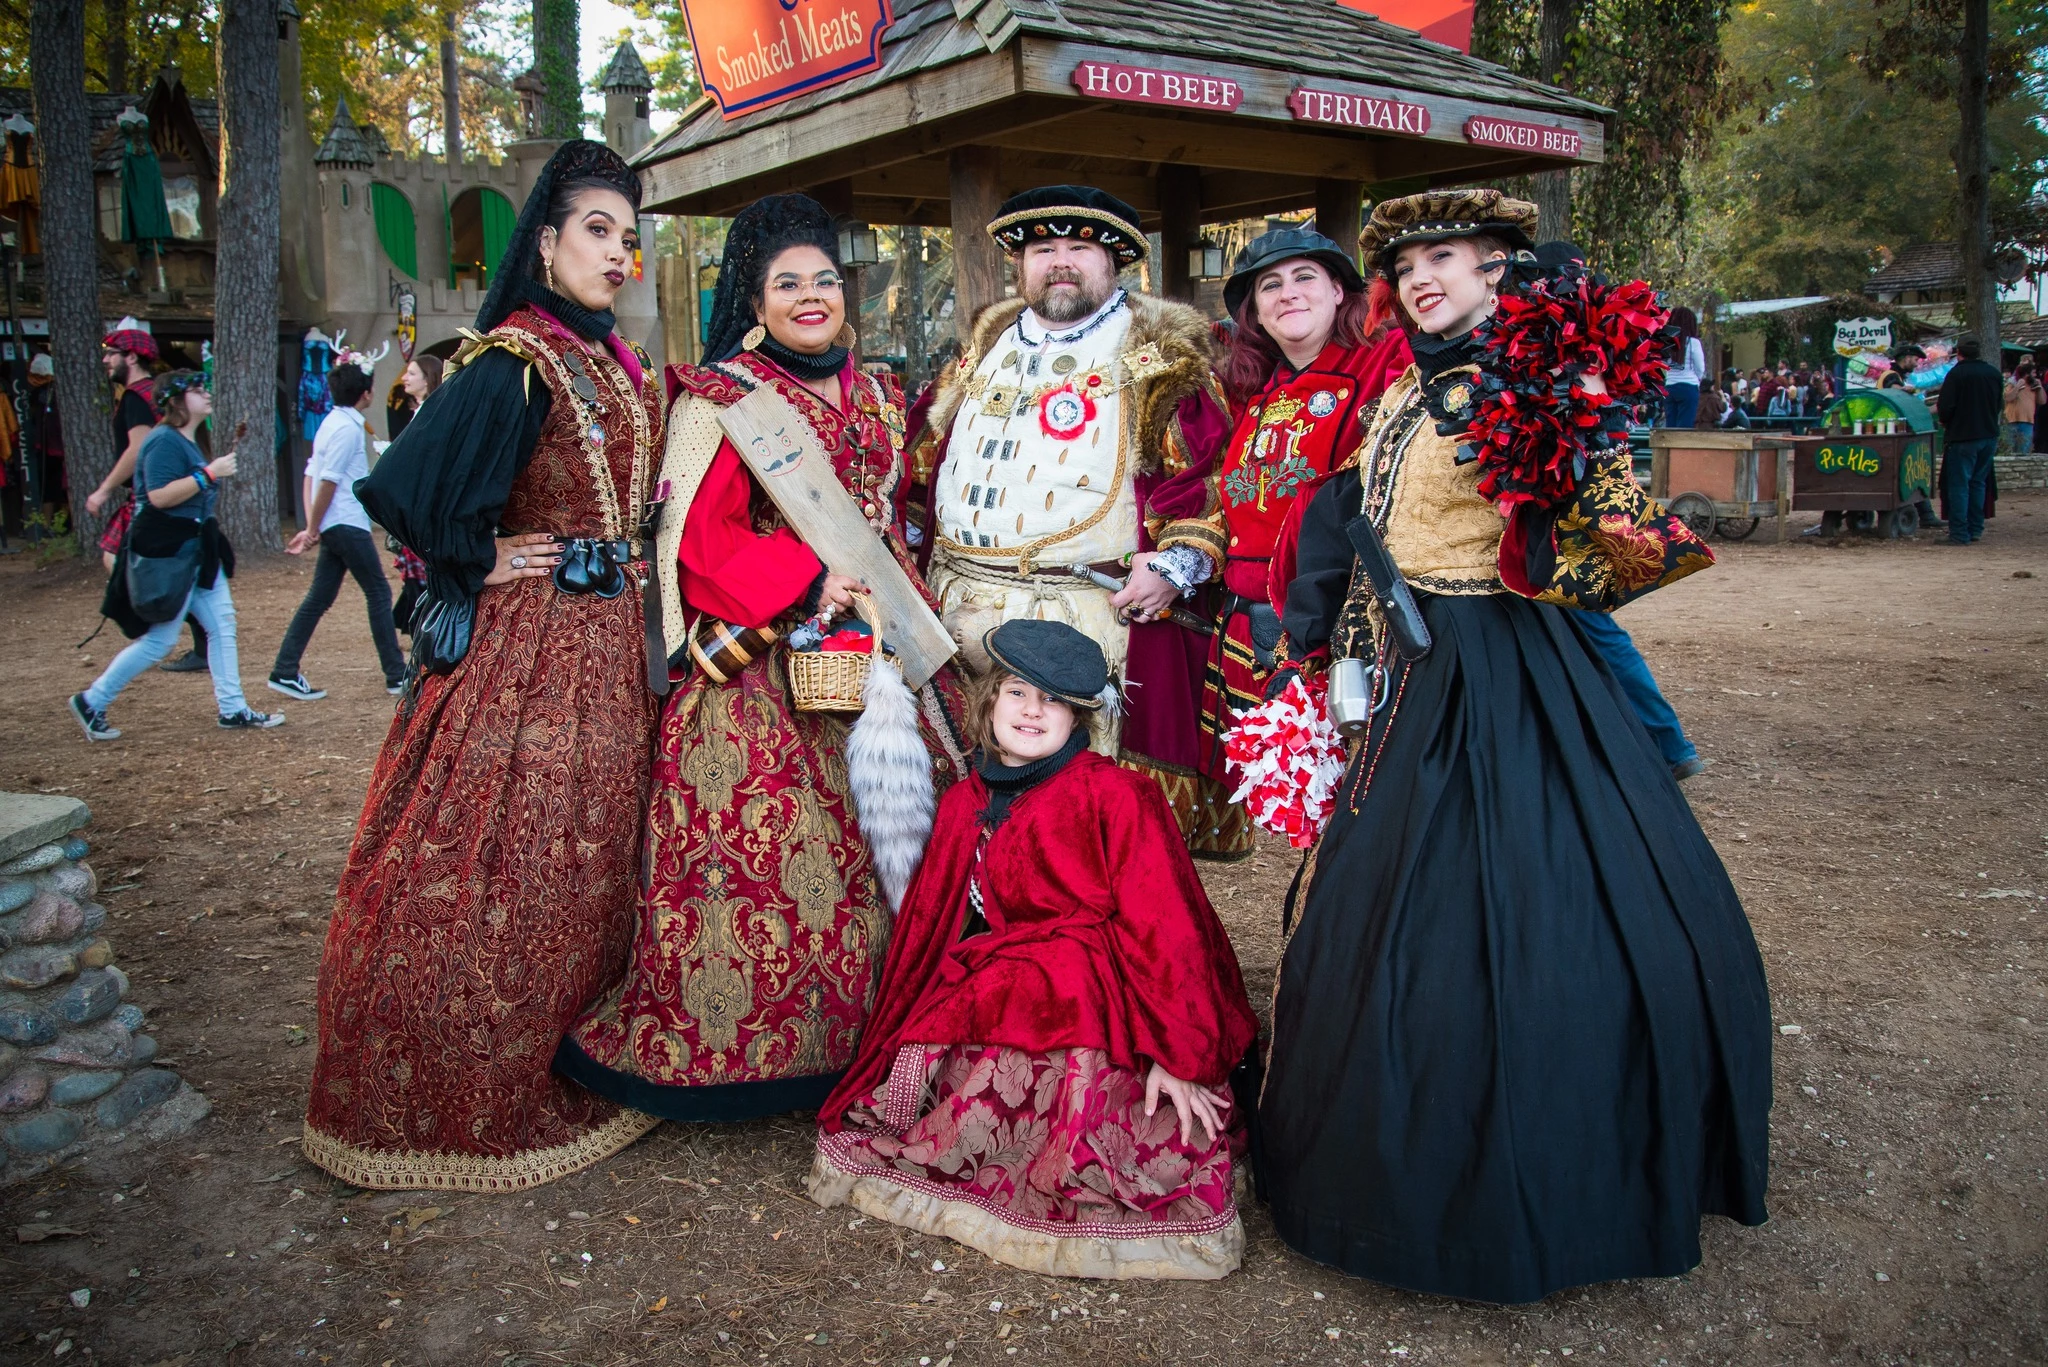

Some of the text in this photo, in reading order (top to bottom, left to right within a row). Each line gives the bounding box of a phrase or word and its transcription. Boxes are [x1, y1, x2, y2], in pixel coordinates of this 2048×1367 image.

[717, 6, 862, 92] Smoked Meats
[1085, 64, 1237, 106] HOT BEEF
[1299, 90, 1426, 133] TERIYAKI
[1471, 120, 1579, 153] SMOKED BEEF
[1838, 325, 1887, 339] Sea Devil
[1848, 337, 1876, 346] Tavern
[1820, 447, 1879, 473] Pickles
